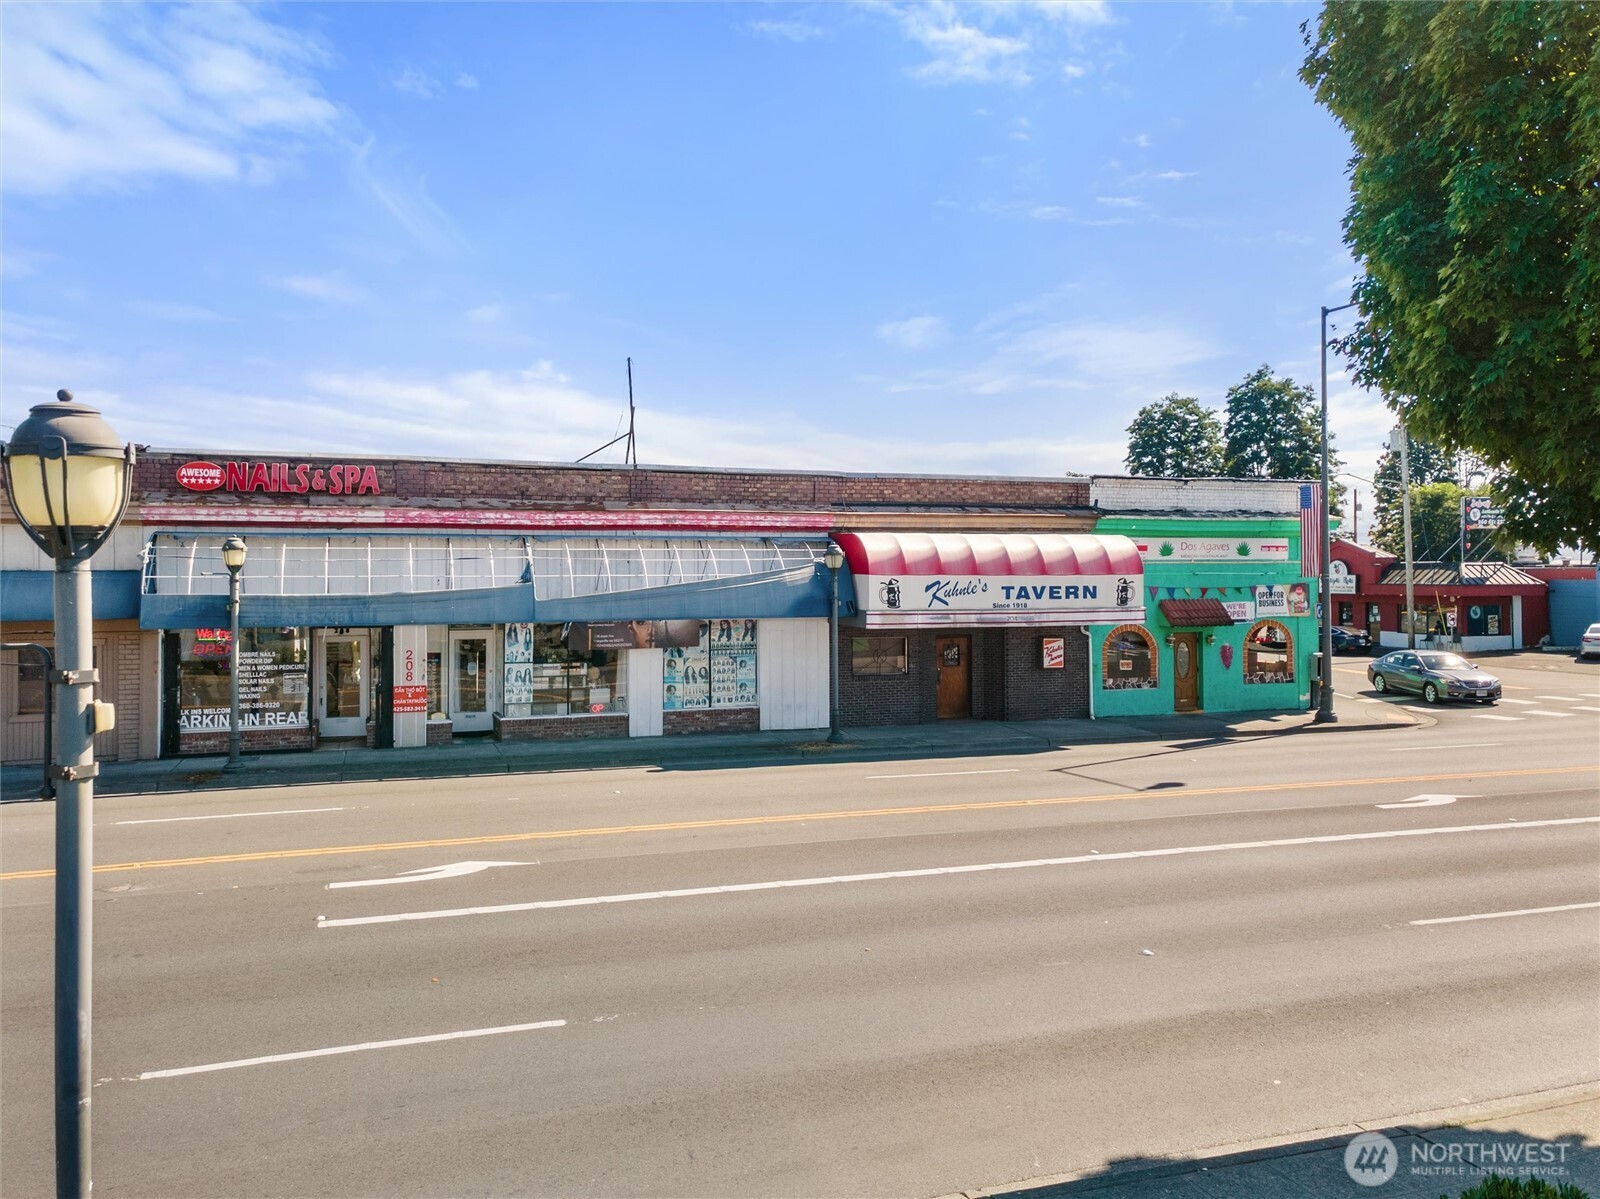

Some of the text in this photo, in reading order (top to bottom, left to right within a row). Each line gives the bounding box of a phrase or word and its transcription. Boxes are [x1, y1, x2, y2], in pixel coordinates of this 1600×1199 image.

[180, 467, 221, 478] AWESOME
[226, 461, 380, 495] NAILS & SPA
[1180, 541, 1230, 553] Dos Agaves
[924, 578, 1098, 608] Kuhnle's TAVERN
[1257, 591, 1285, 599] OPEN FOR
[1227, 610, 1247, 618] OPEN
[244, 712, 260, 726] IN
[265, 711, 309, 726] REAR
